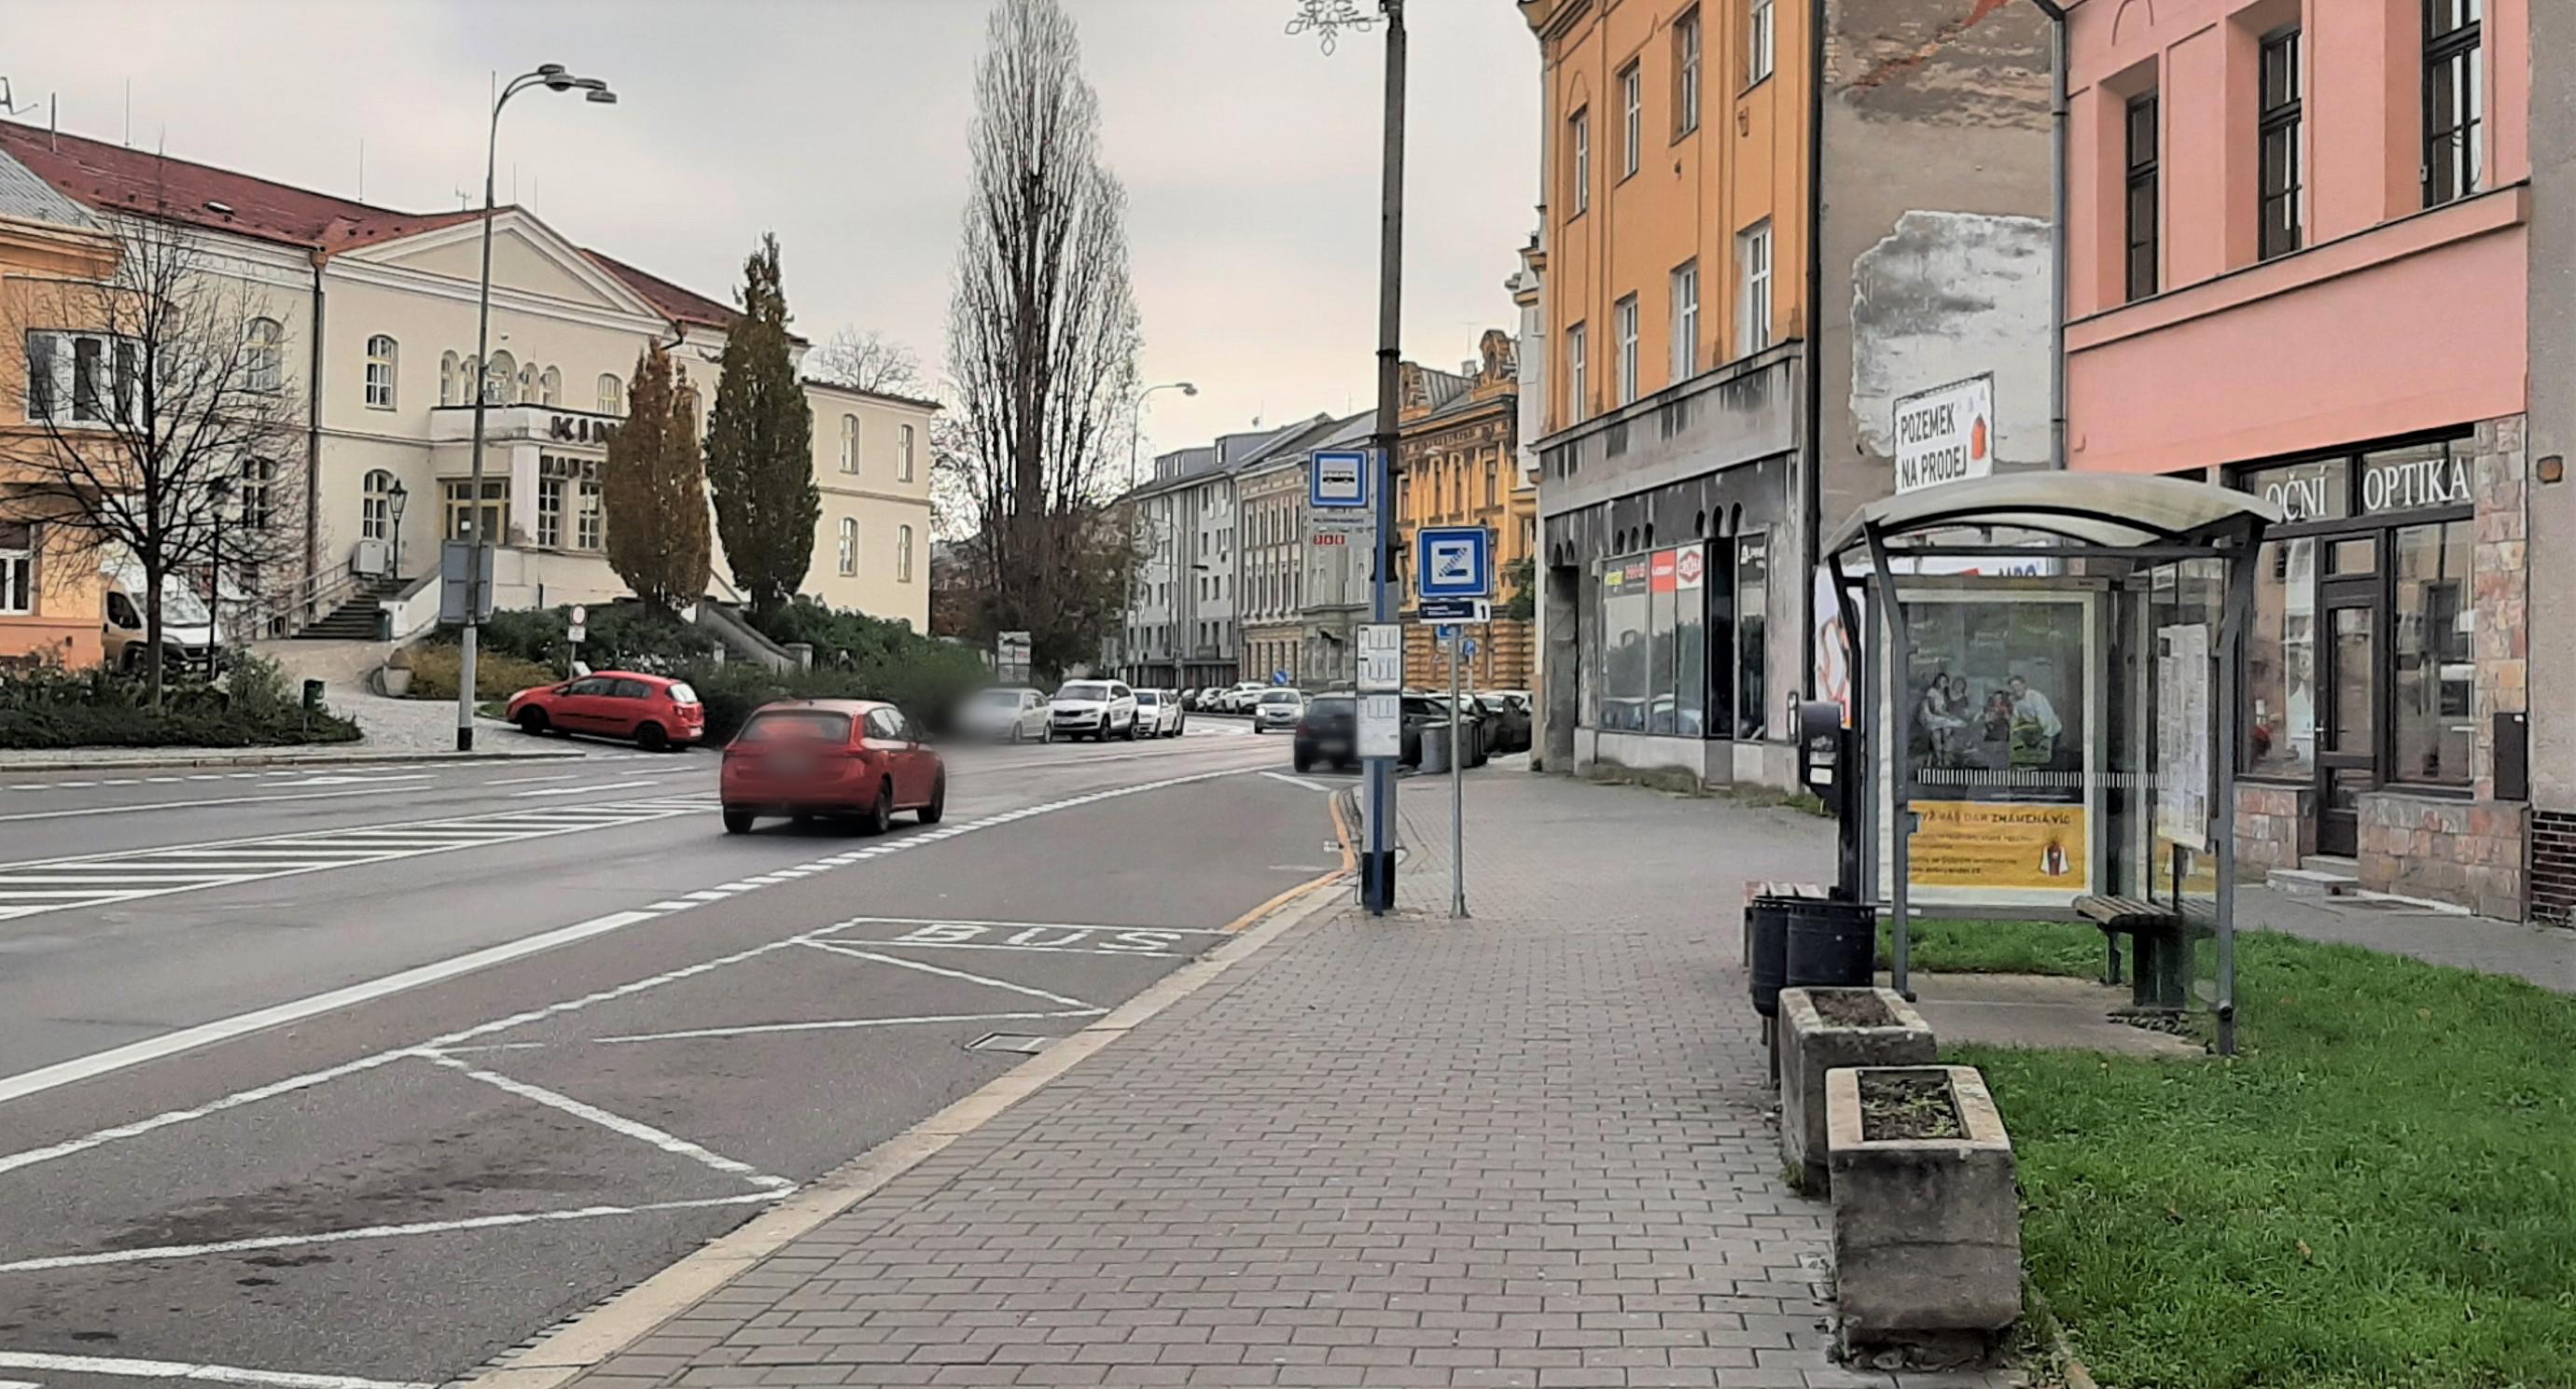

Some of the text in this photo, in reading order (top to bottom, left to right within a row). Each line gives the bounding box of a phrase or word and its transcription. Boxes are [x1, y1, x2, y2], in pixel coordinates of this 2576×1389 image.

[550, 416, 617, 444] KIN
[1901, 402, 1956, 445] POZEMEK
[1901, 444, 1968, 489] NA PRODEJ
[2265, 455, 2471, 521] OČNÍ OPTIKA
[1480, 604, 1486, 619] 1
[894, 923, 1182, 951] BUS
